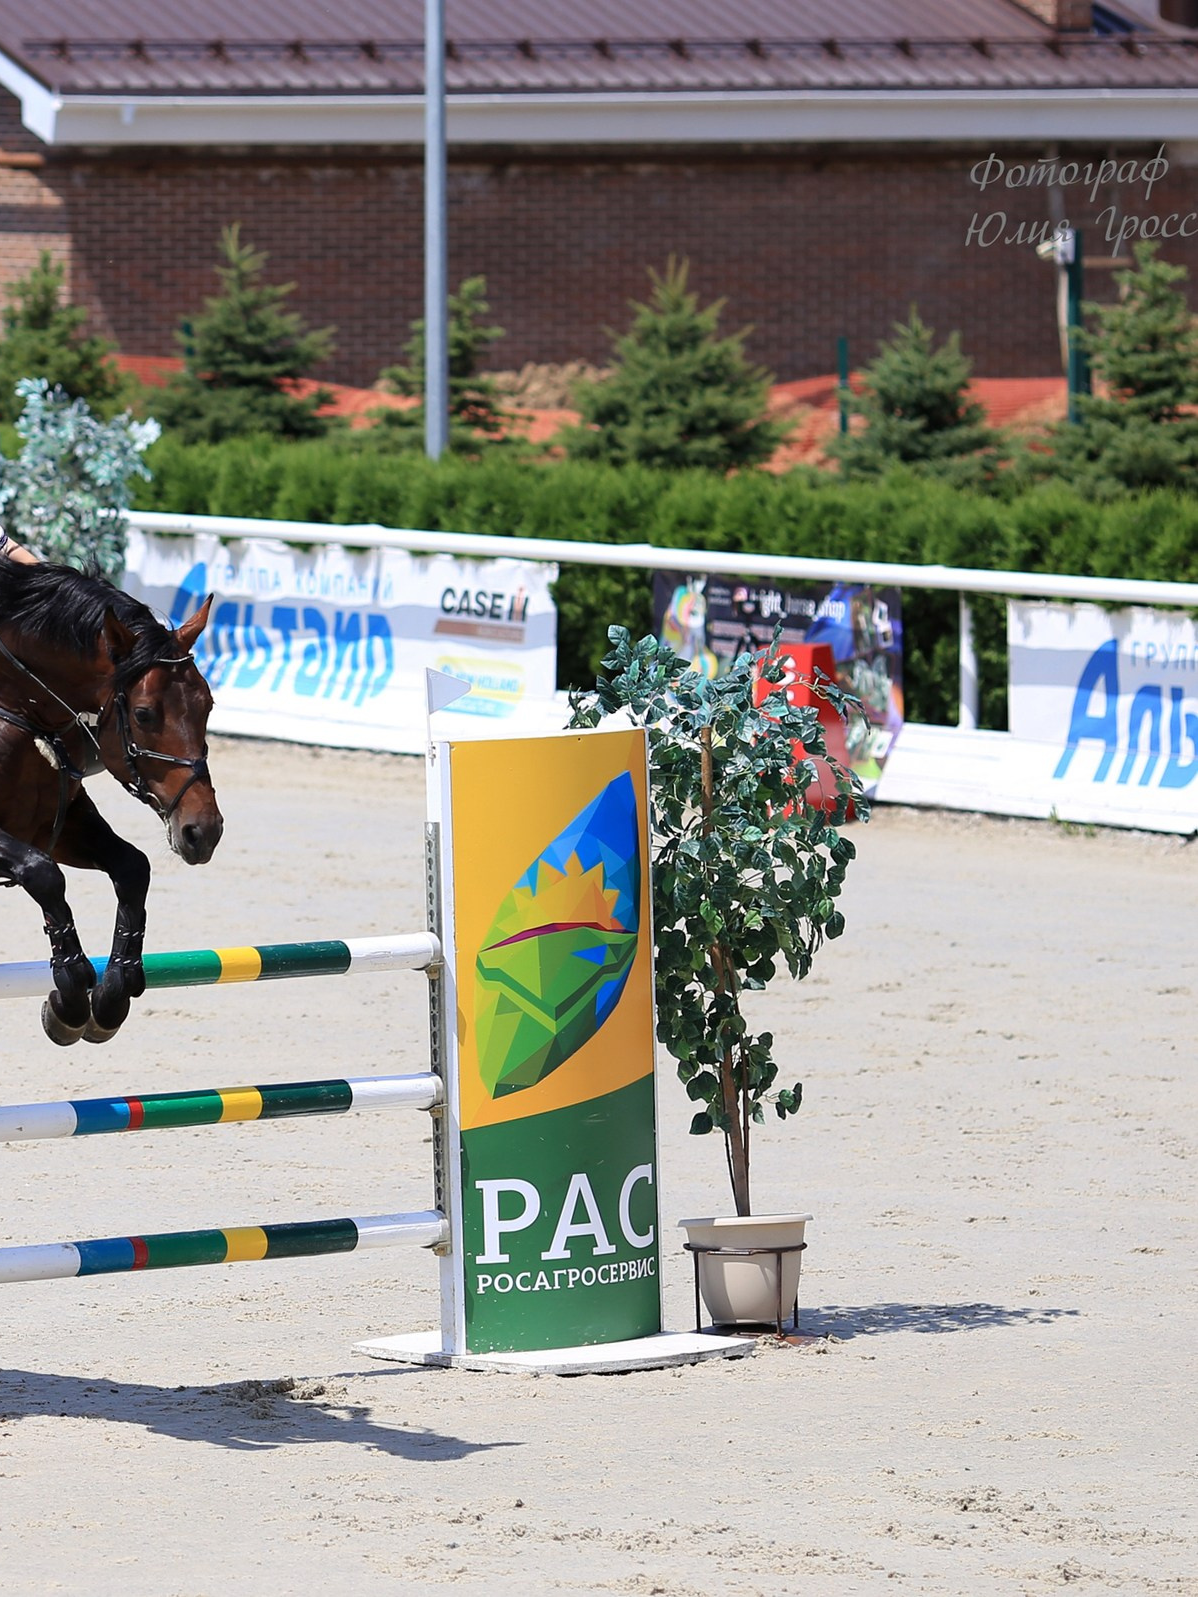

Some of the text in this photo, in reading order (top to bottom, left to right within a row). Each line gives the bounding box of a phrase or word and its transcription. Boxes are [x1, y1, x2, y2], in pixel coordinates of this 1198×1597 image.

[440, 587, 505, 620] CASE
[475, 1163, 654, 1264] РАС
[476, 1256, 656, 1294] РОСАГРОСЕРВИС
